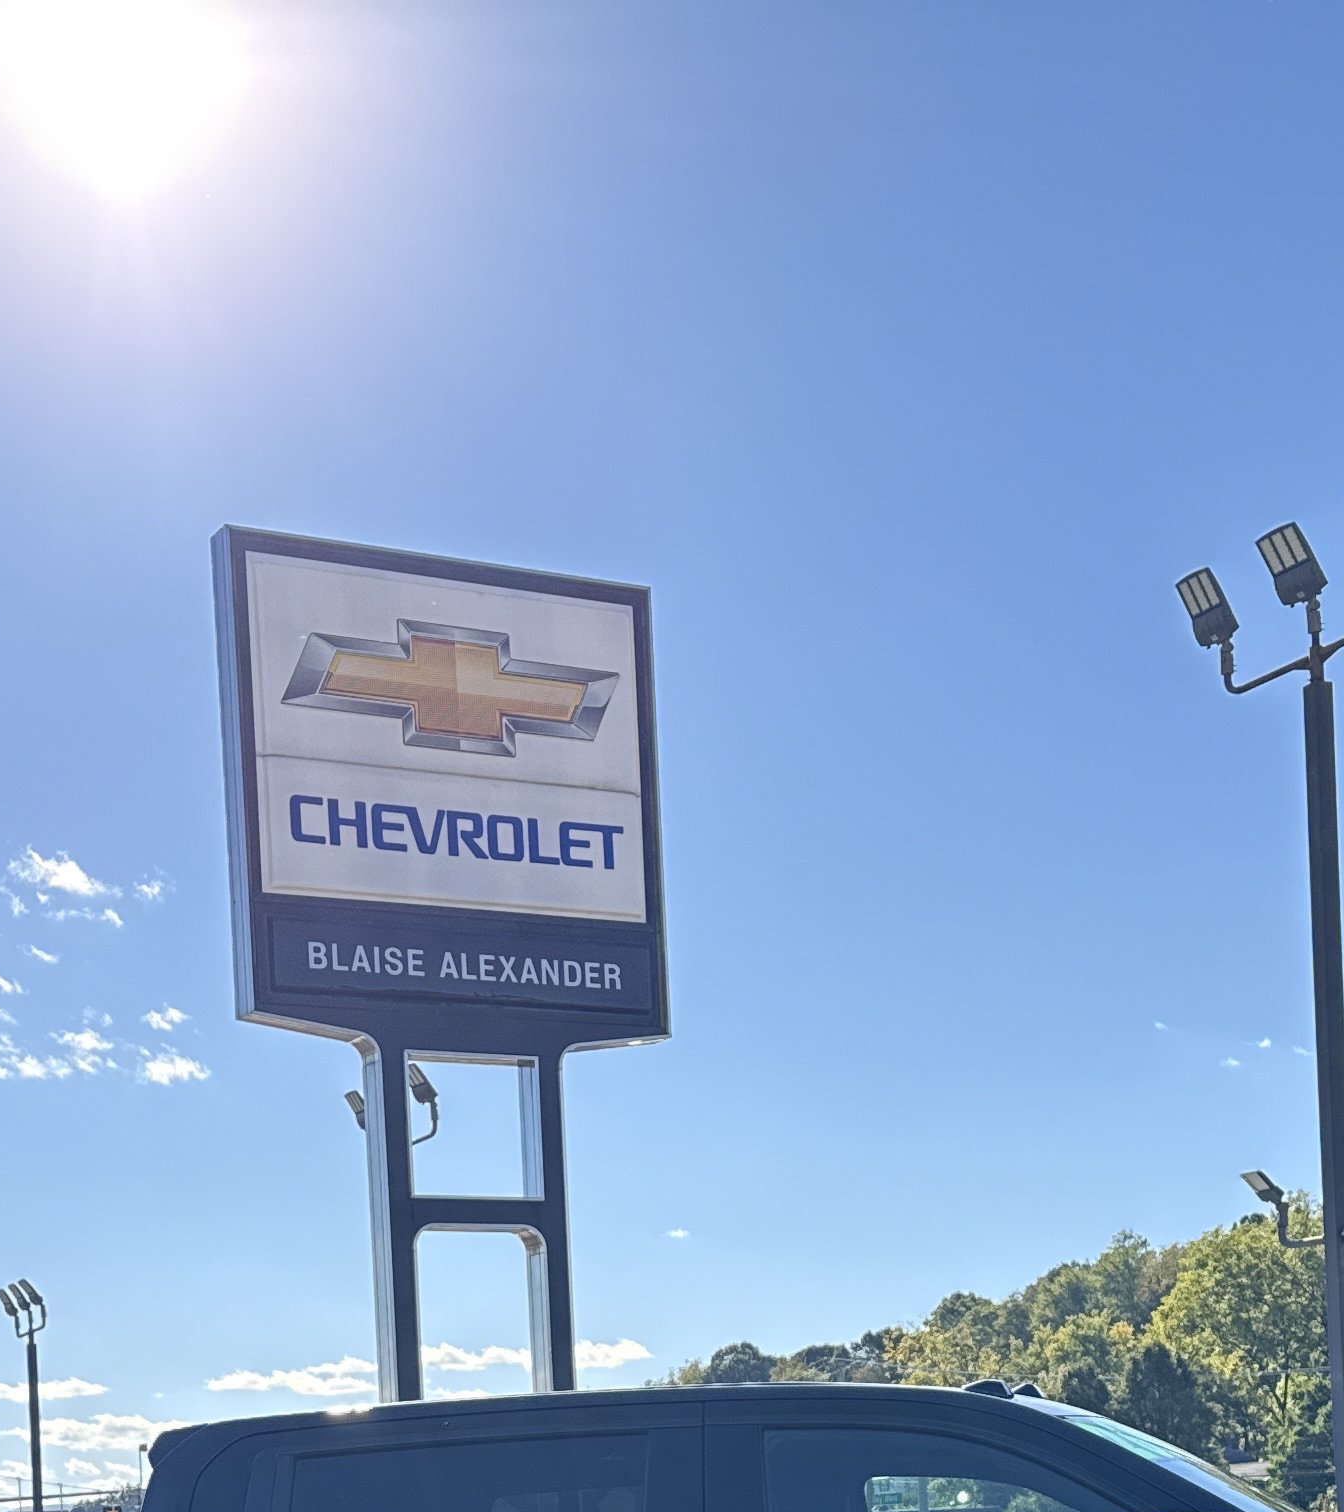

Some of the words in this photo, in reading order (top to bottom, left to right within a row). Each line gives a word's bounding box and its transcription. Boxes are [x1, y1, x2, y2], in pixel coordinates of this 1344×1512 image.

[289, 794, 624, 870] CHEVROLET
[307, 941, 426, 977] BLAISE
[440, 951, 622, 990] ALEXANDER
